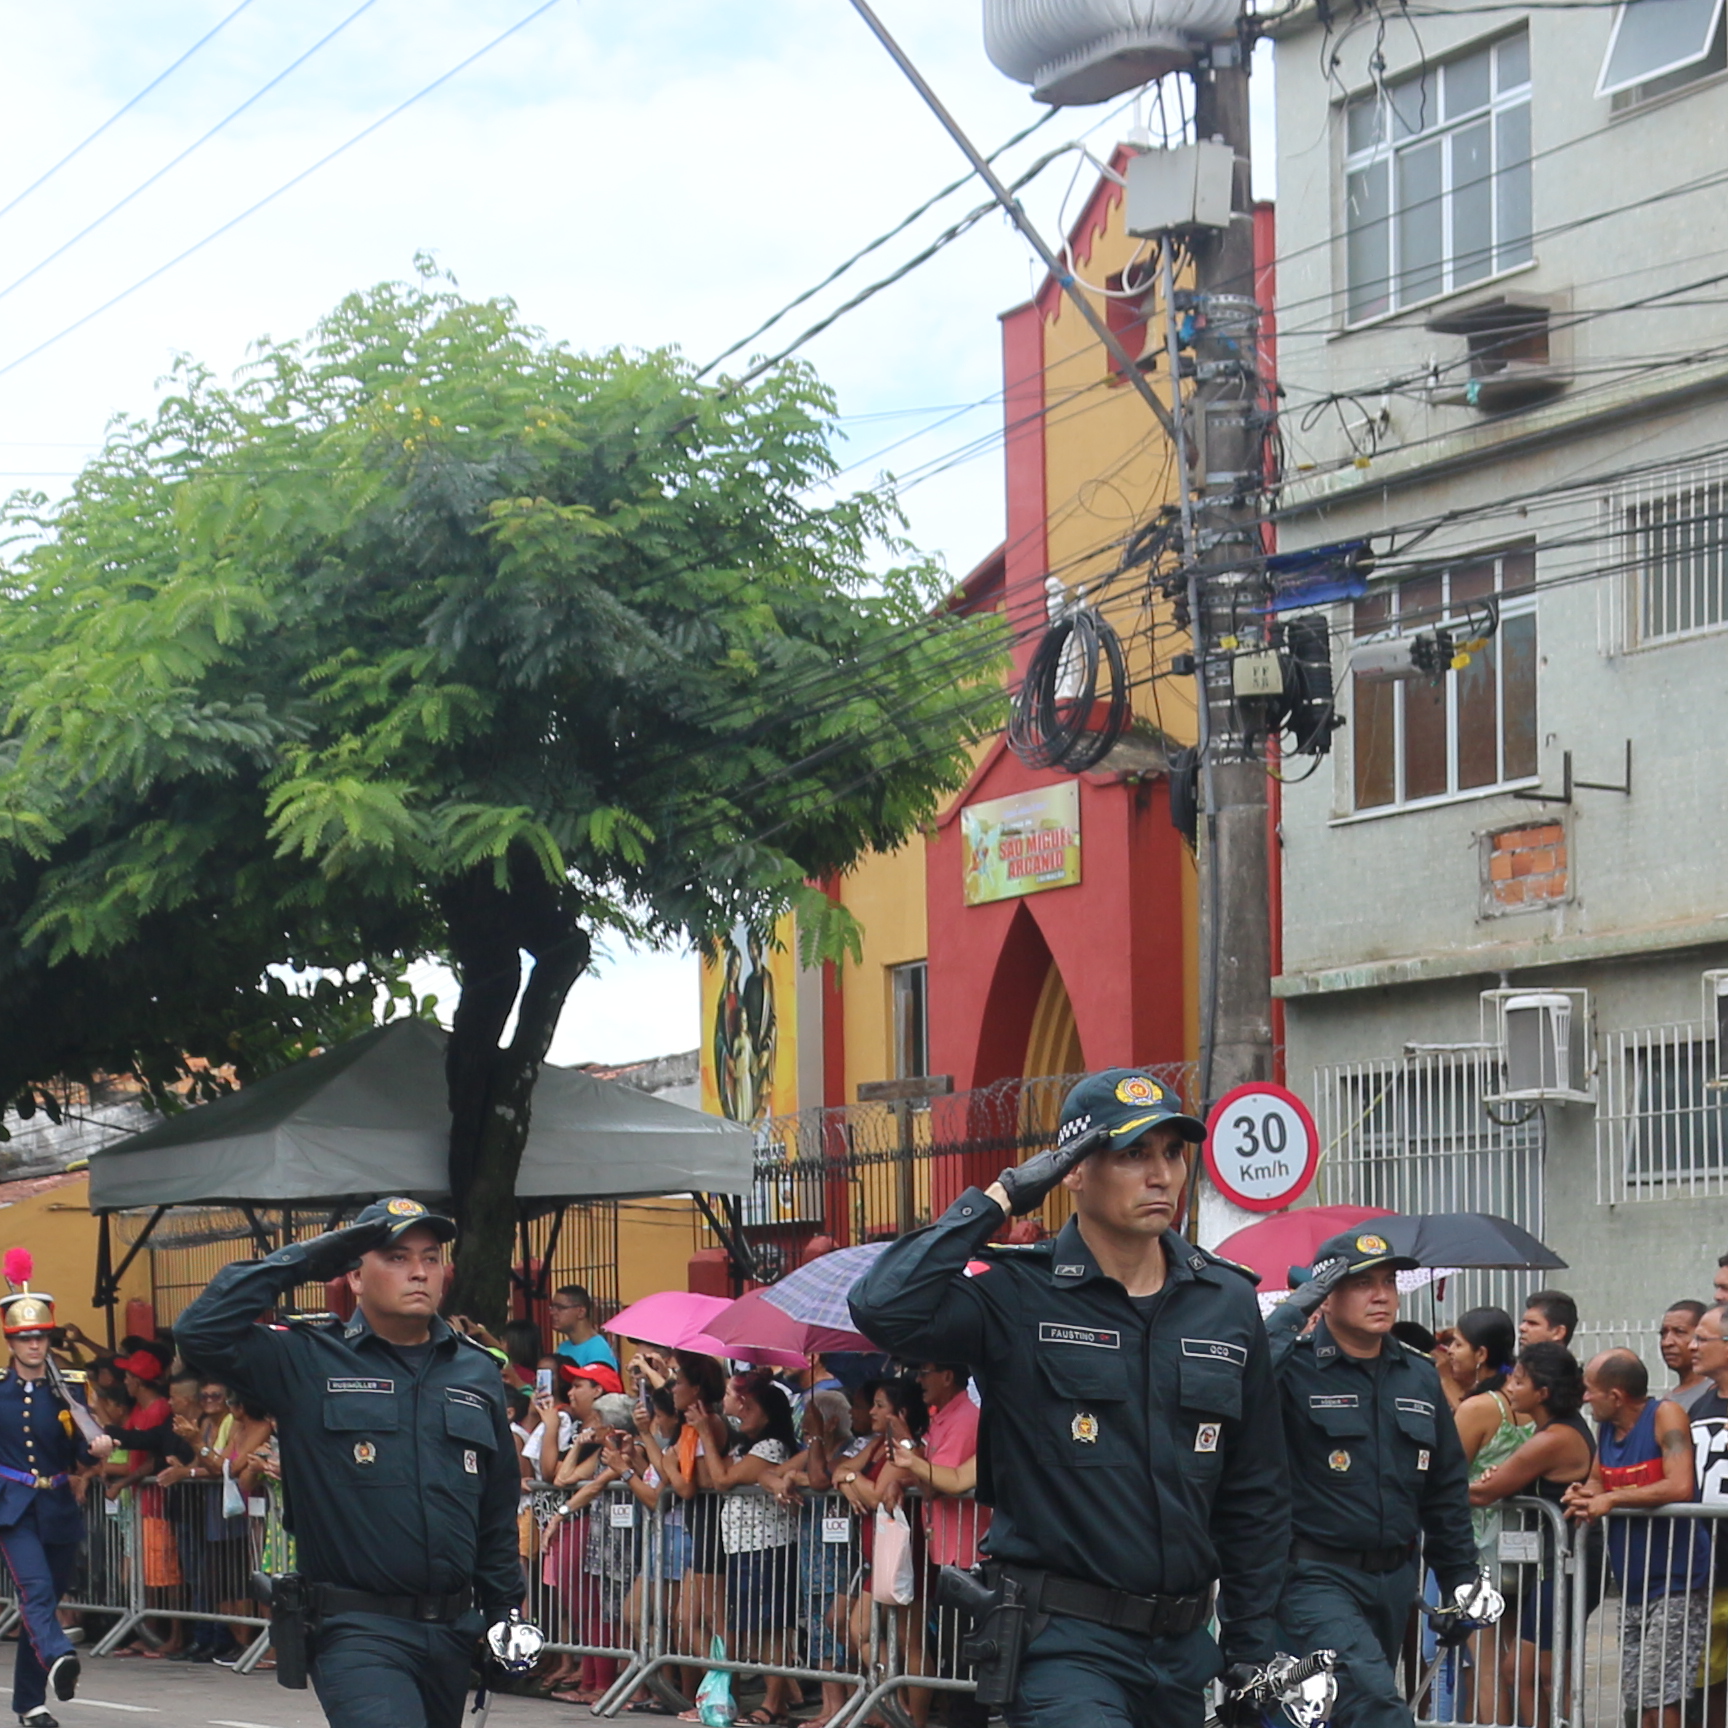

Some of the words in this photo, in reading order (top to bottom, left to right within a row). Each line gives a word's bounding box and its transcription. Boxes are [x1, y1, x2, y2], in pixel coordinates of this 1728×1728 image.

[1027, 826, 1074, 856] MIGUEL
[1233, 1112, 1287, 1158] 30
[1240, 1160, 1289, 1182] Km/h
[1050, 1328, 1095, 1342] FAUSTINO
[826, 1521, 846, 1531] LOC
